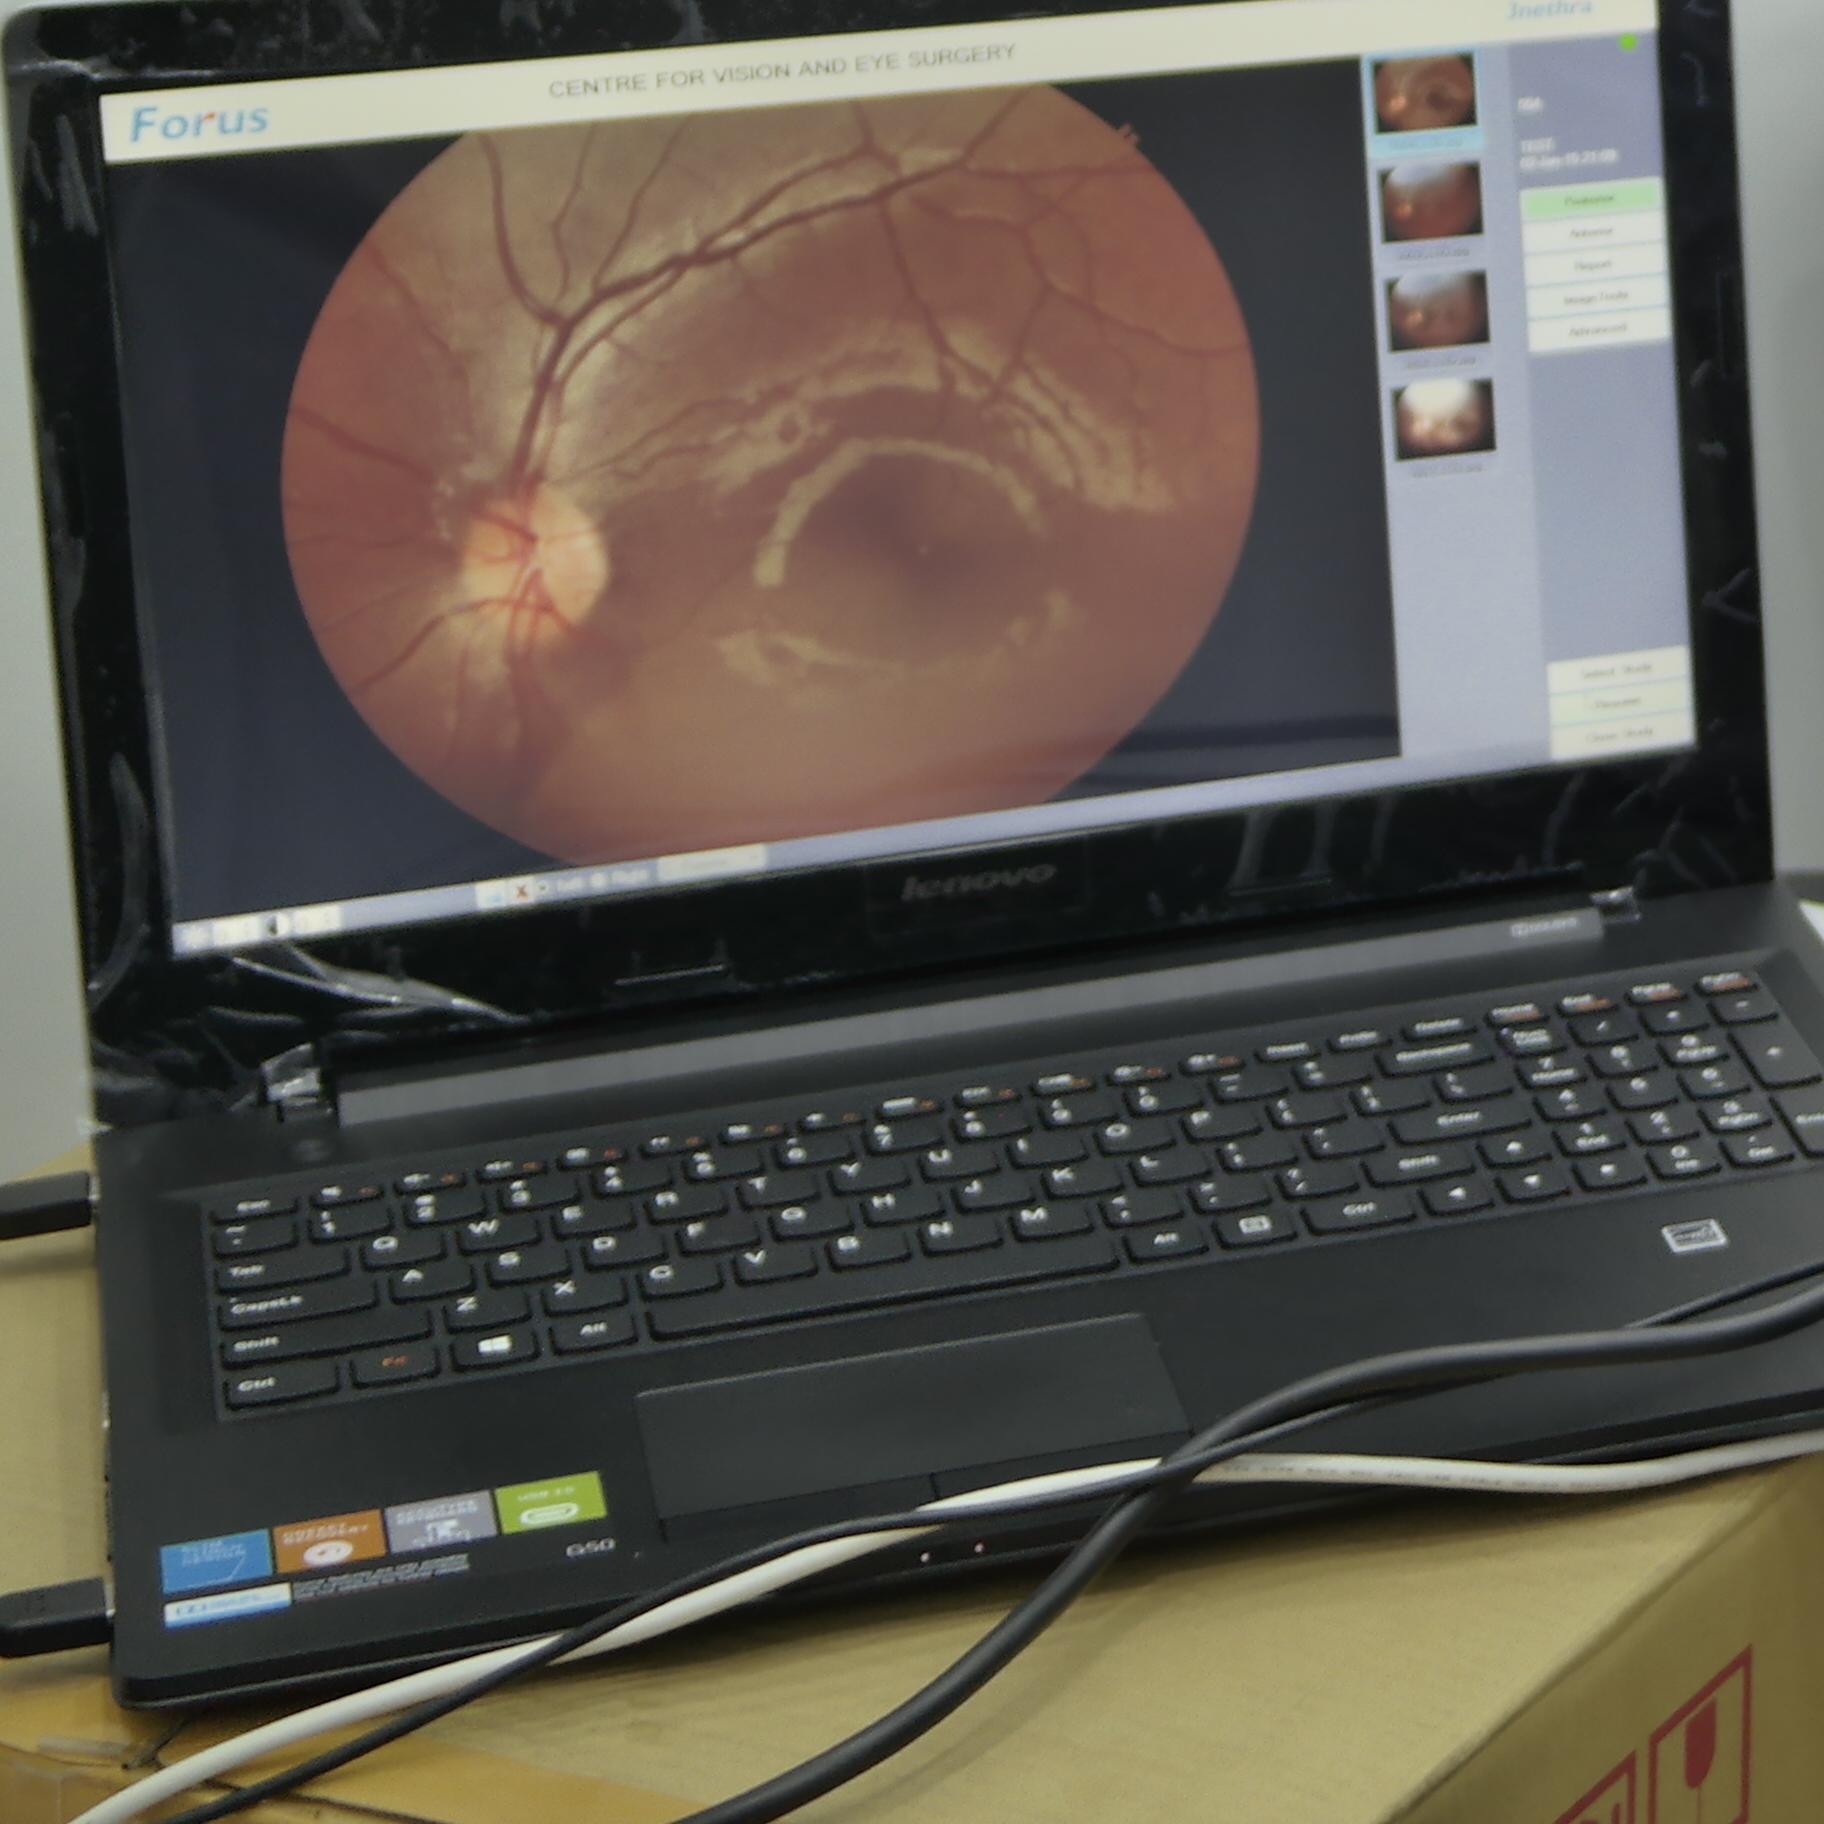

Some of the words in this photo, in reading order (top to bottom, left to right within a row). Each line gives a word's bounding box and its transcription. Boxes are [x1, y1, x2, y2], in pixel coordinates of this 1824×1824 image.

[548, 77, 647, 98] CENTRE
[656, 67, 705, 89] FOR
[713, 62, 791, 83] VISION
[798, 57, 846, 77] AND
[855, 52, 899, 73] EYE
[909, 43, 1016, 68] SURGERY
[131, 107, 271, 143] Forus
